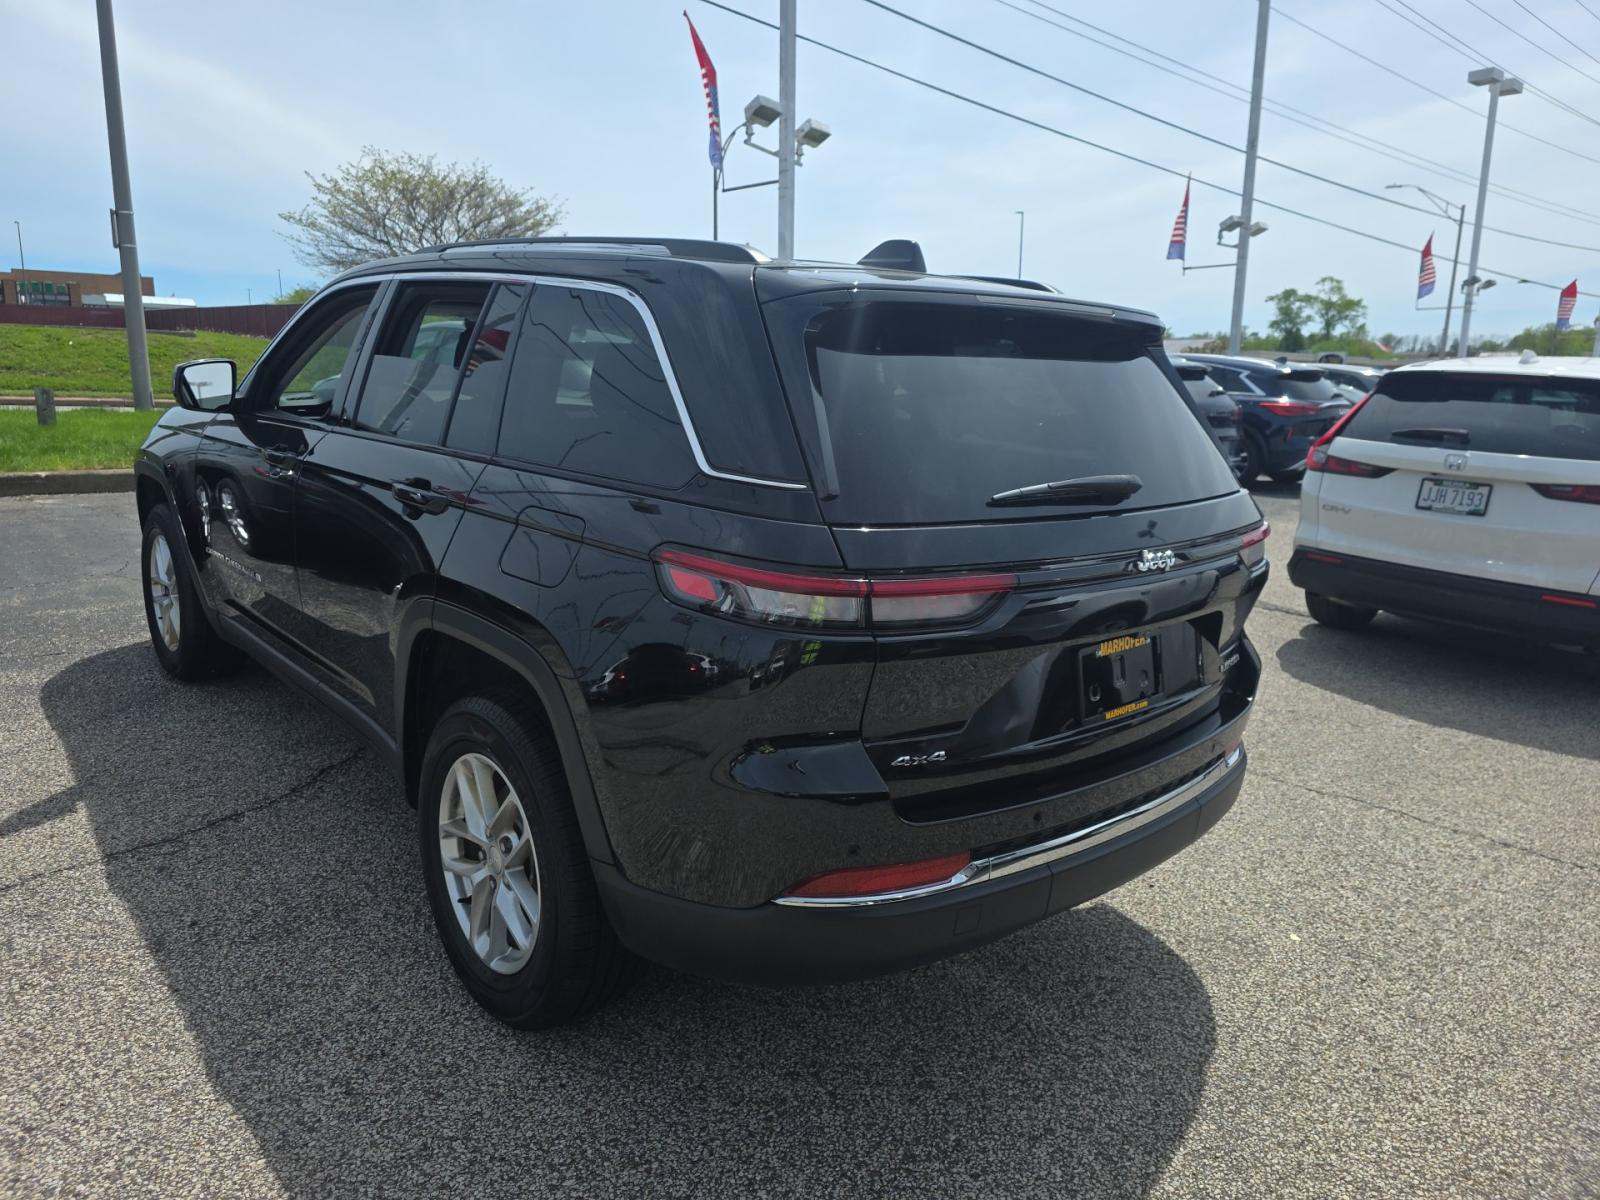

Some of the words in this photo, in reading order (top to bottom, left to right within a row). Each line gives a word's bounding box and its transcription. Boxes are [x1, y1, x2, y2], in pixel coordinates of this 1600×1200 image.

[1423, 487, 1448, 504] JJH
[1450, 490, 1484, 508] 7193
[1137, 549, 1176, 572] Jeep
[890, 750, 947, 767] 4x4
